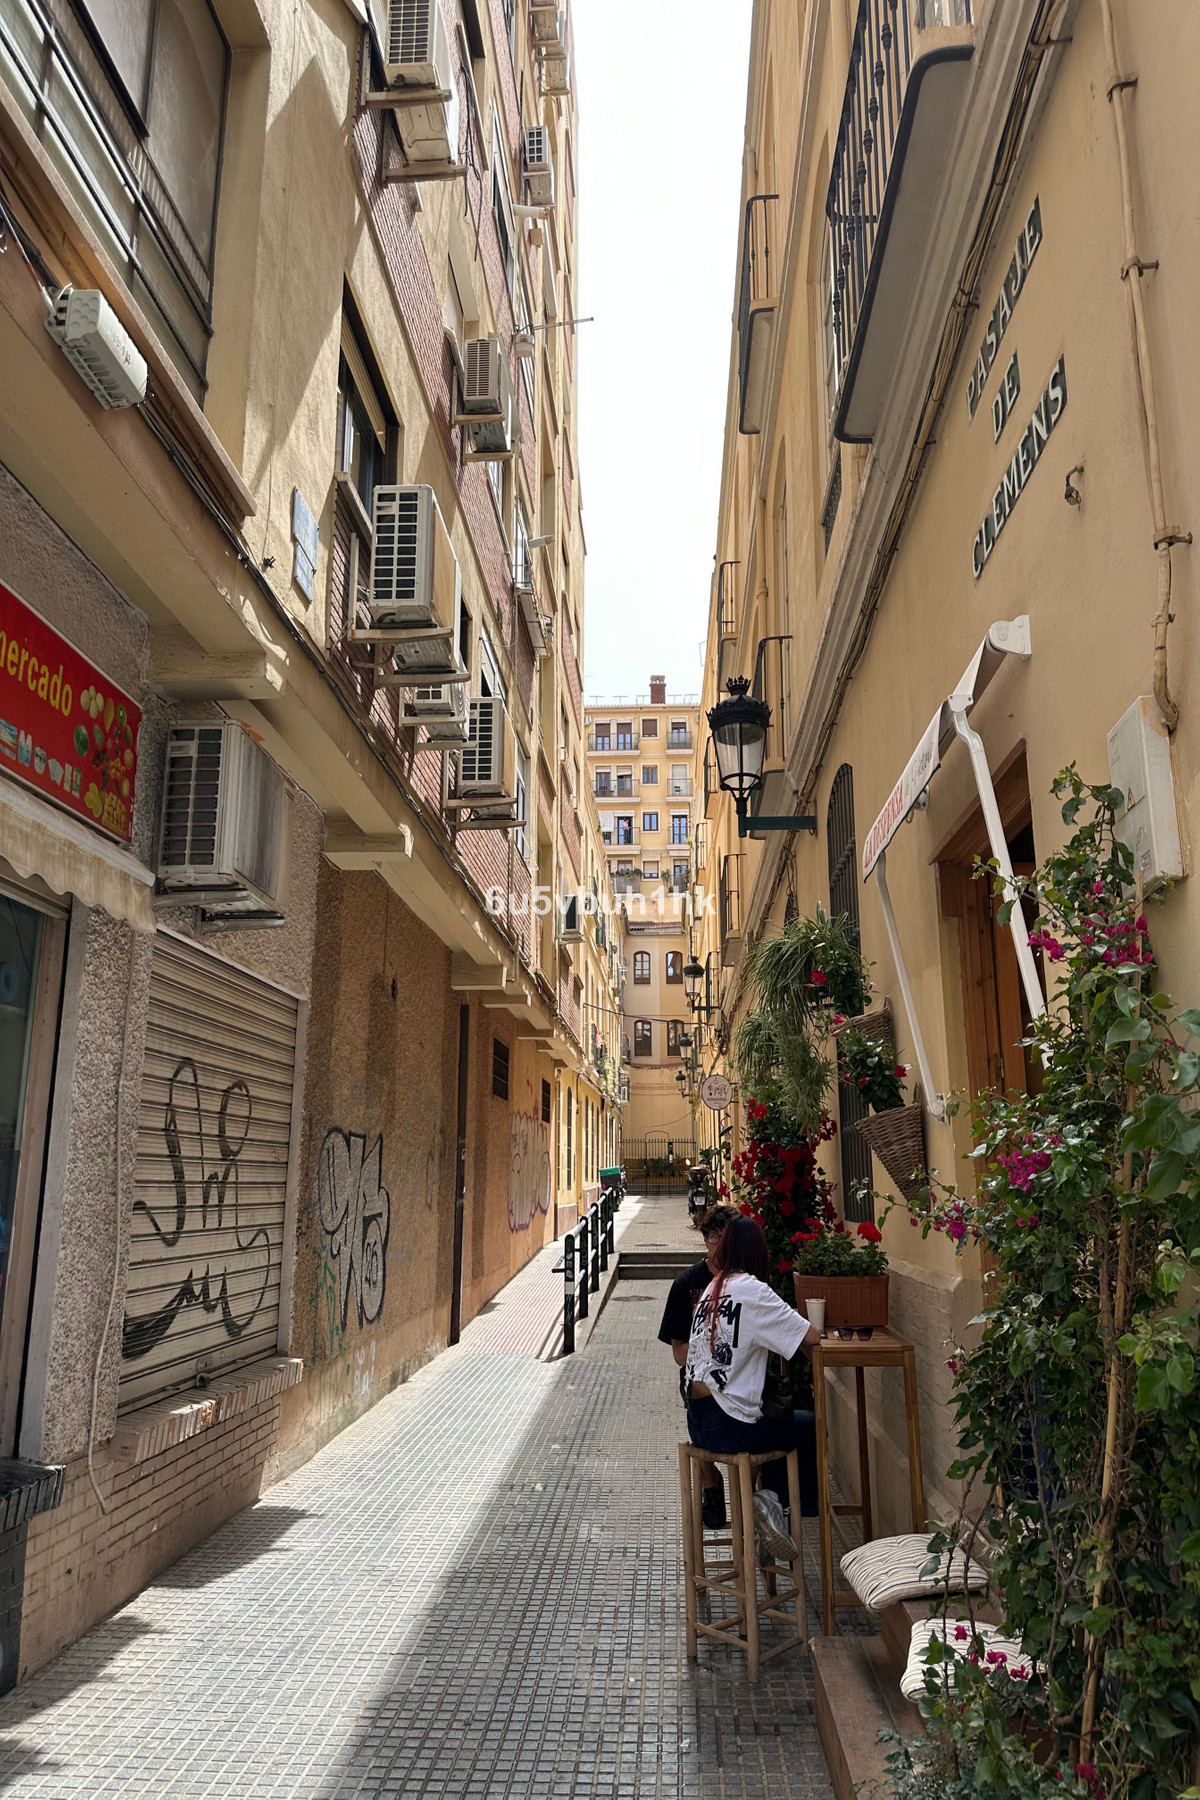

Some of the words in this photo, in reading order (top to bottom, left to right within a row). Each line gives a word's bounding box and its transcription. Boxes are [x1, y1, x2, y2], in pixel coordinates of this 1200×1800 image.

[966, 203, 1042, 421] PASAJE
[992, 359, 1019, 441] DE
[972, 363, 1066, 579] CLEMENS
